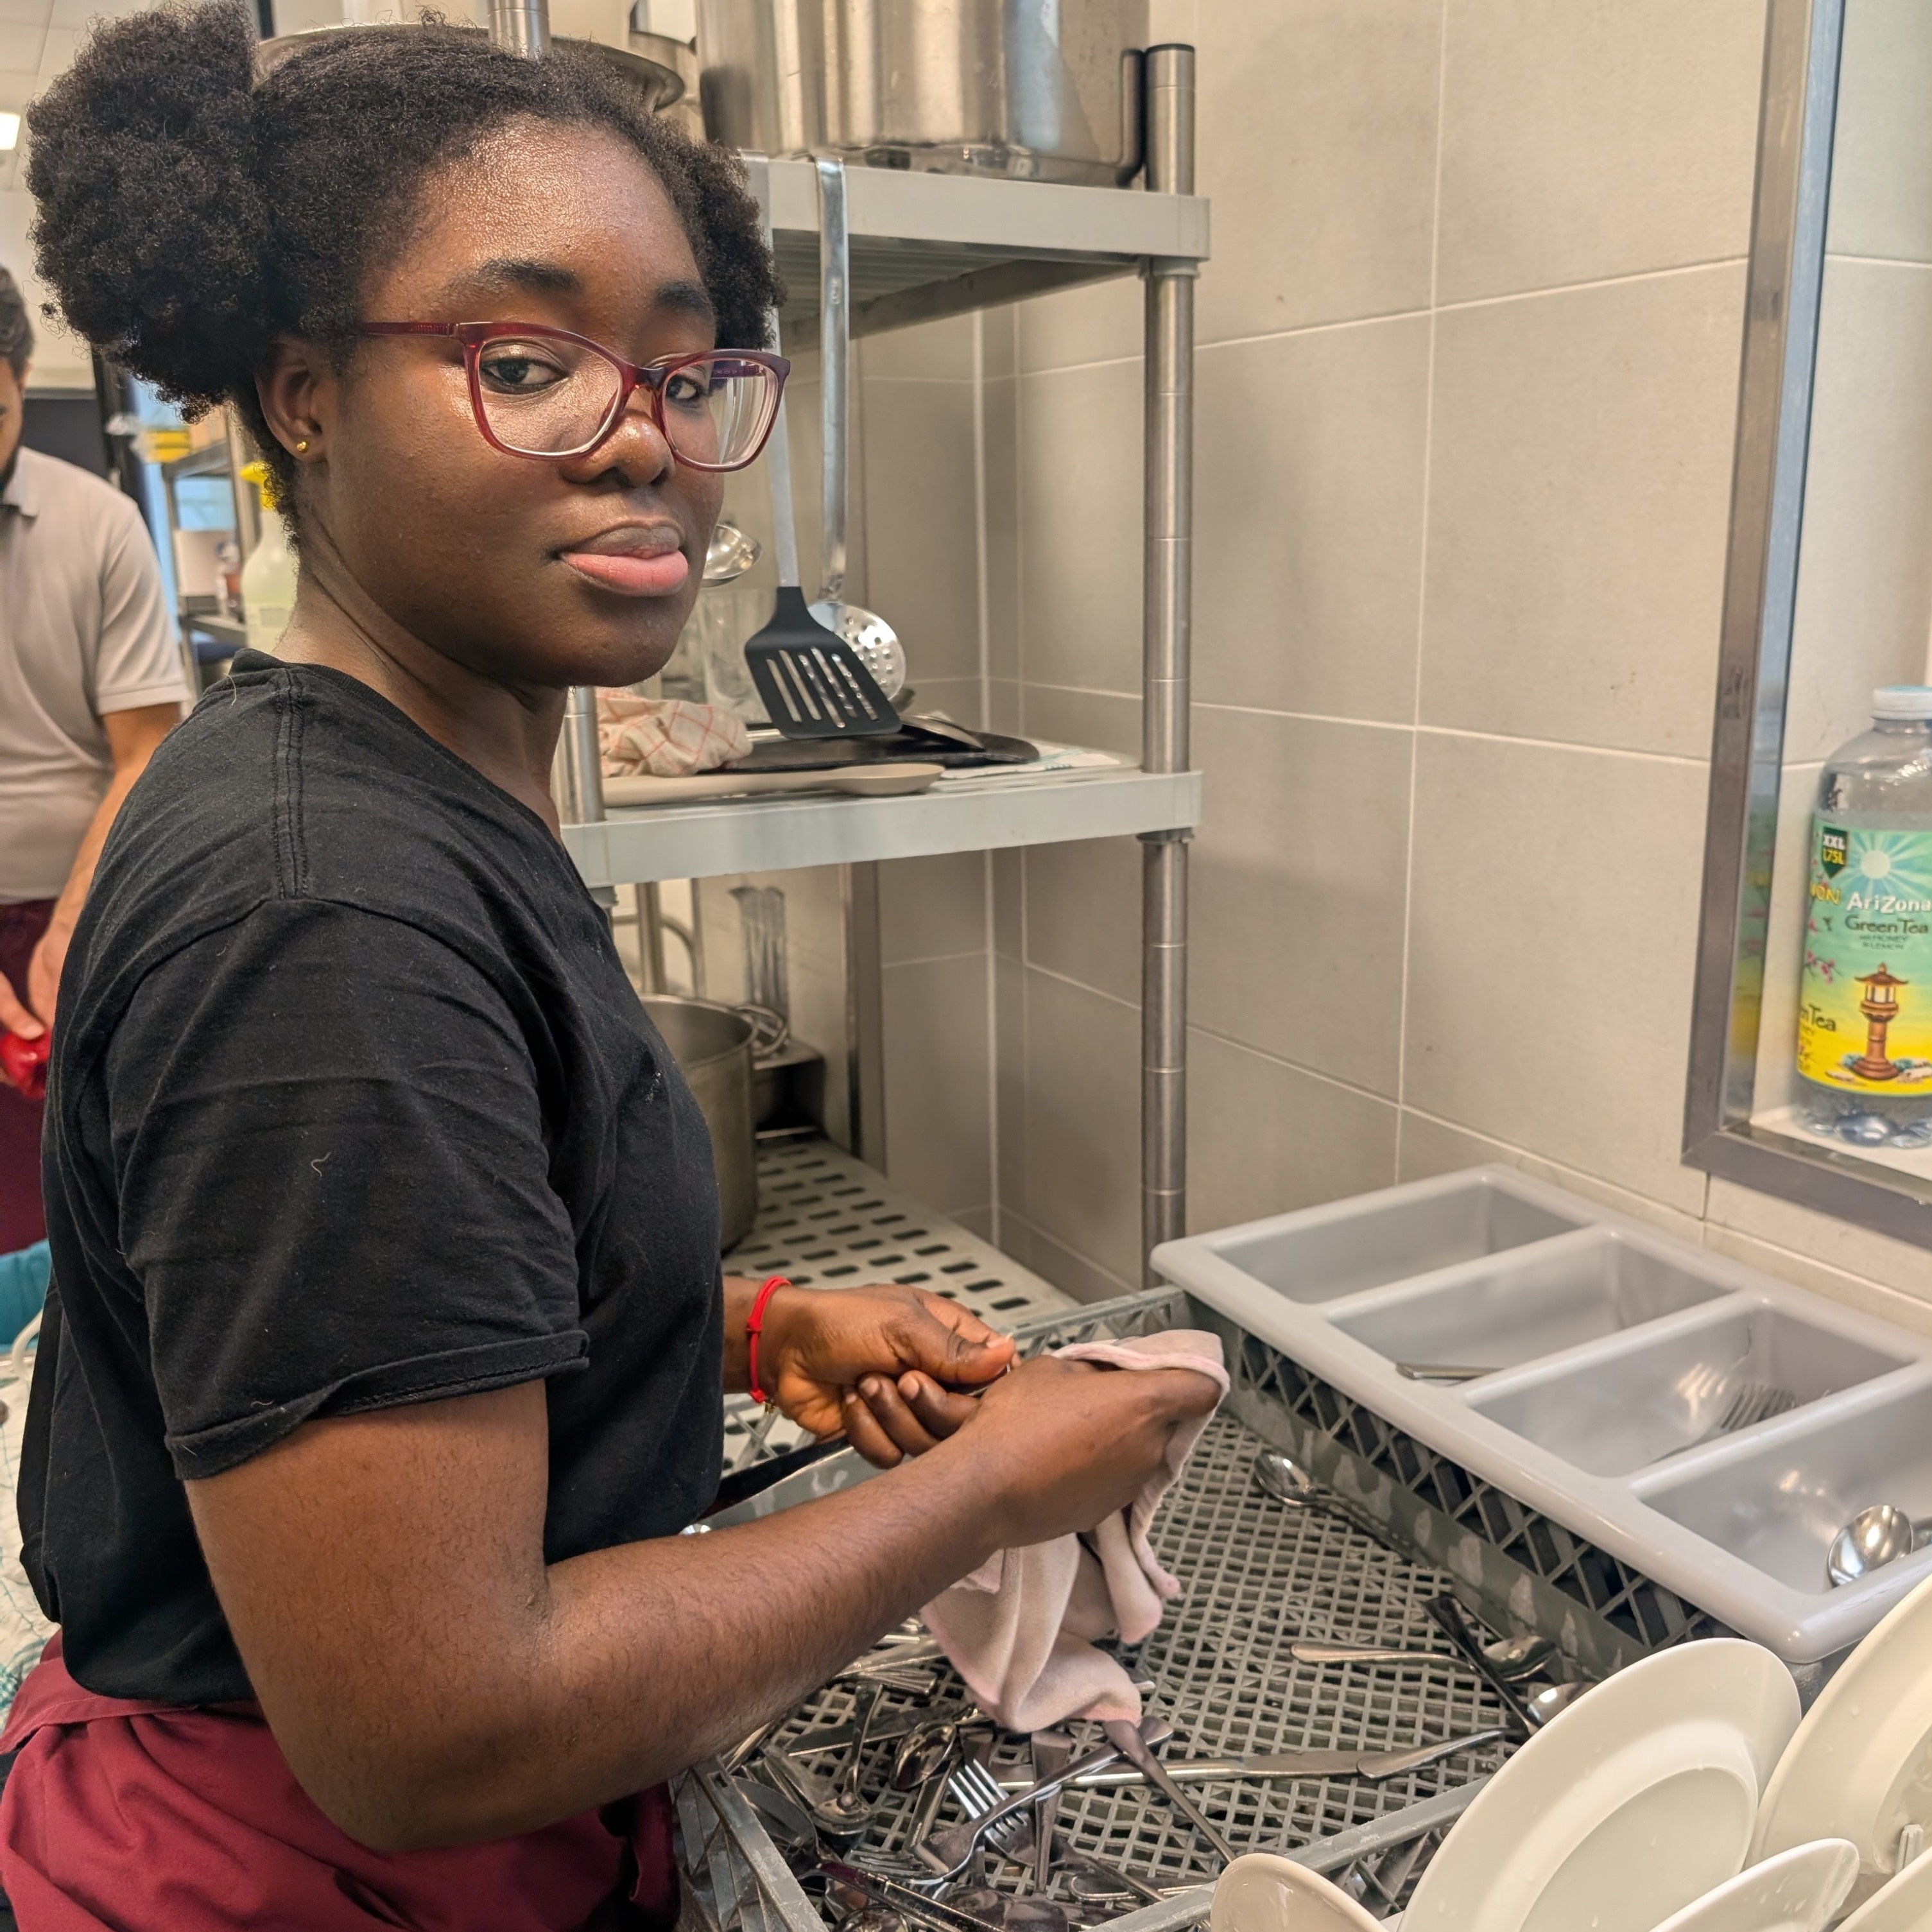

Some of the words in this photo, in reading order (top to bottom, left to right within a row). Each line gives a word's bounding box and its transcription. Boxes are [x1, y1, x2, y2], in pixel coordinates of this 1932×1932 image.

[1823, 834, 1845, 850] XXL
[1846, 892, 1932, 915] AriZona
[1845, 914, 1898, 933] Green
[1897, 918, 1929, 934] Tea
[1808, 1003, 1836, 1032] Tea
